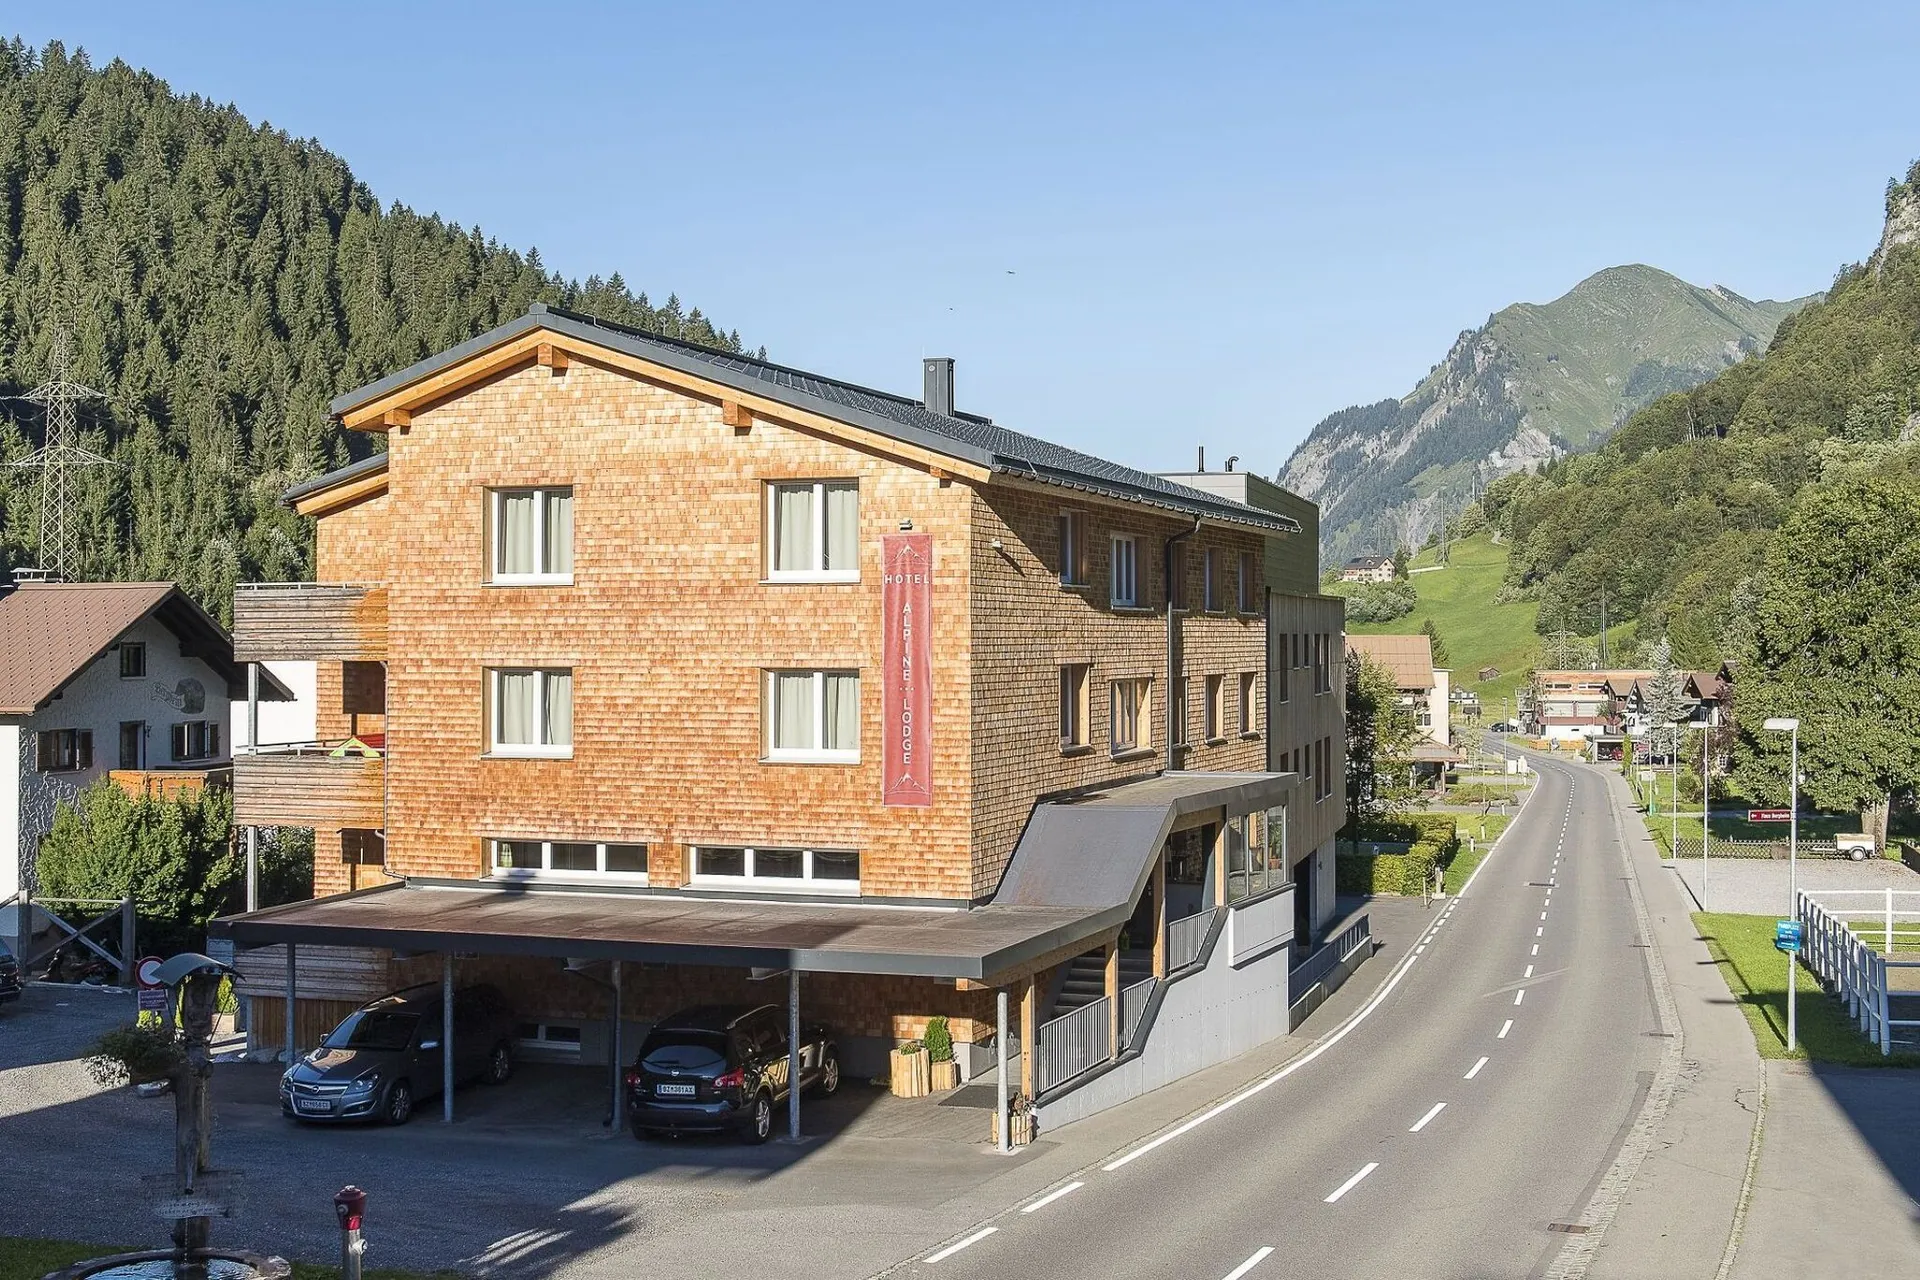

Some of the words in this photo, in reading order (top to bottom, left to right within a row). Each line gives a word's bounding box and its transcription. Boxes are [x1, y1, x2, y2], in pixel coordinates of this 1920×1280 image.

[884, 574, 929, 584] HOTEL
[902, 602, 912, 681] ALPINE
[902, 699, 912, 764] LODGE
